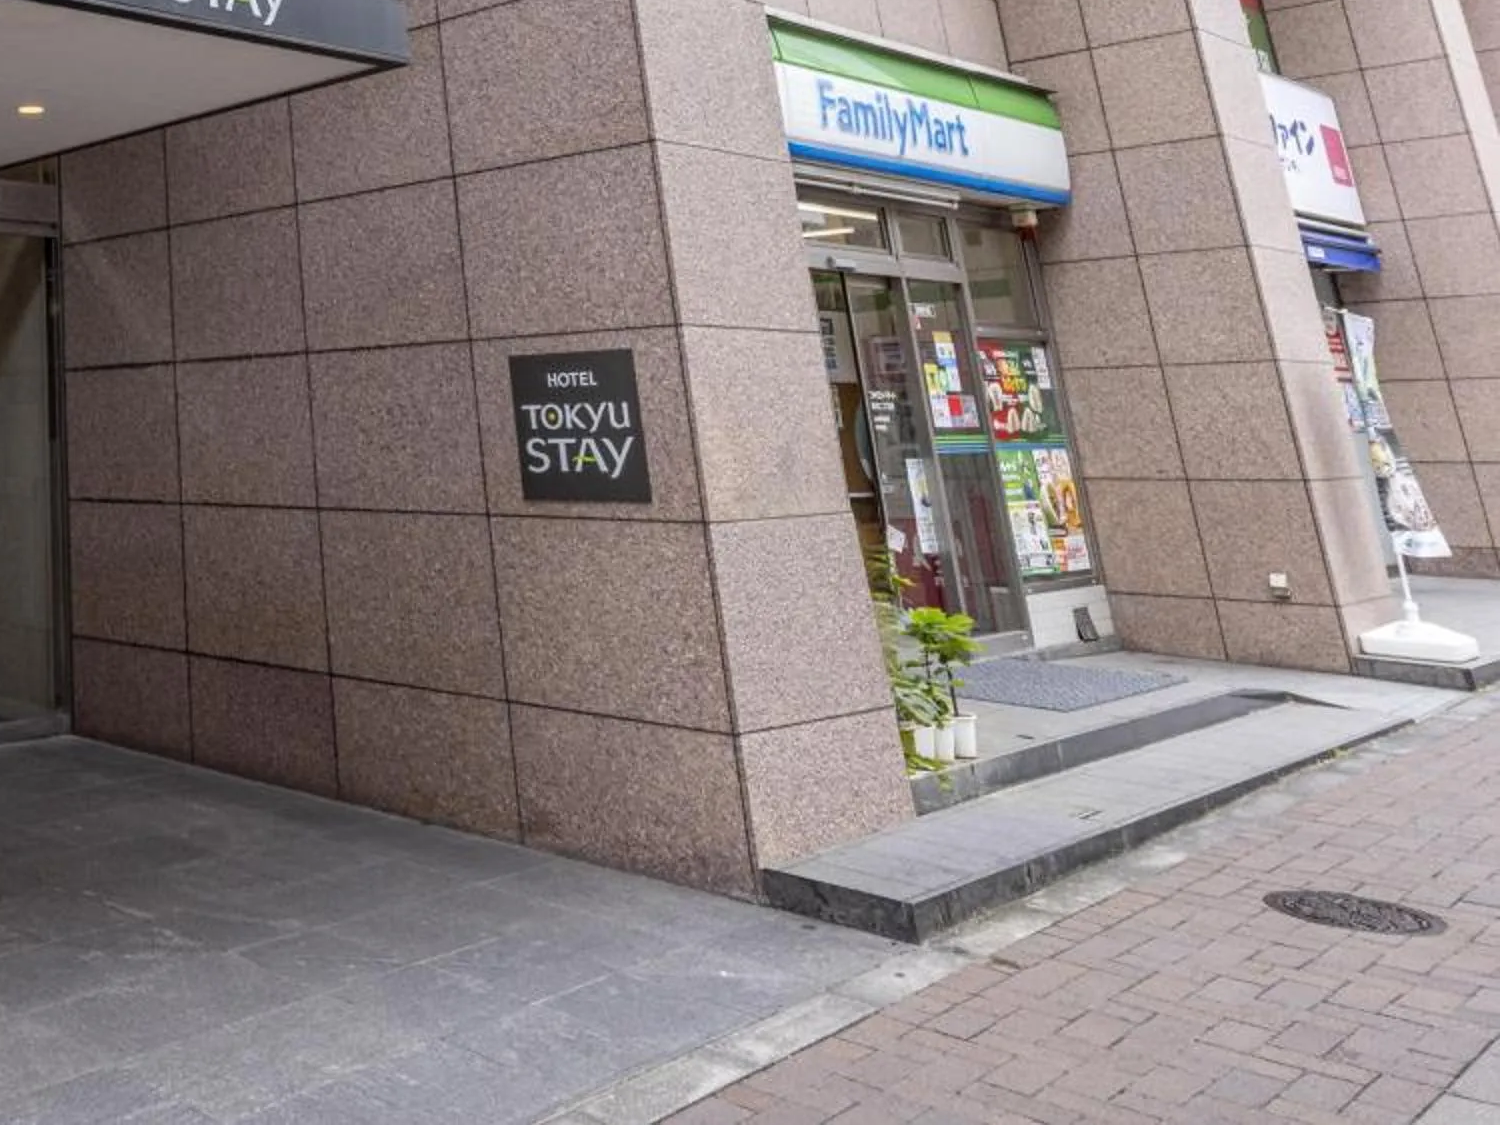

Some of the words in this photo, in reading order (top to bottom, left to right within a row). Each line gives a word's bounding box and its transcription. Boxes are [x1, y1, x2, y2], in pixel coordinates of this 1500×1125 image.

[816, 78, 969, 157] FamilyMart
[547, 370, 598, 388] HOTEL
[520, 400, 631, 434] TOKYU
[525, 435, 635, 479] STAY
